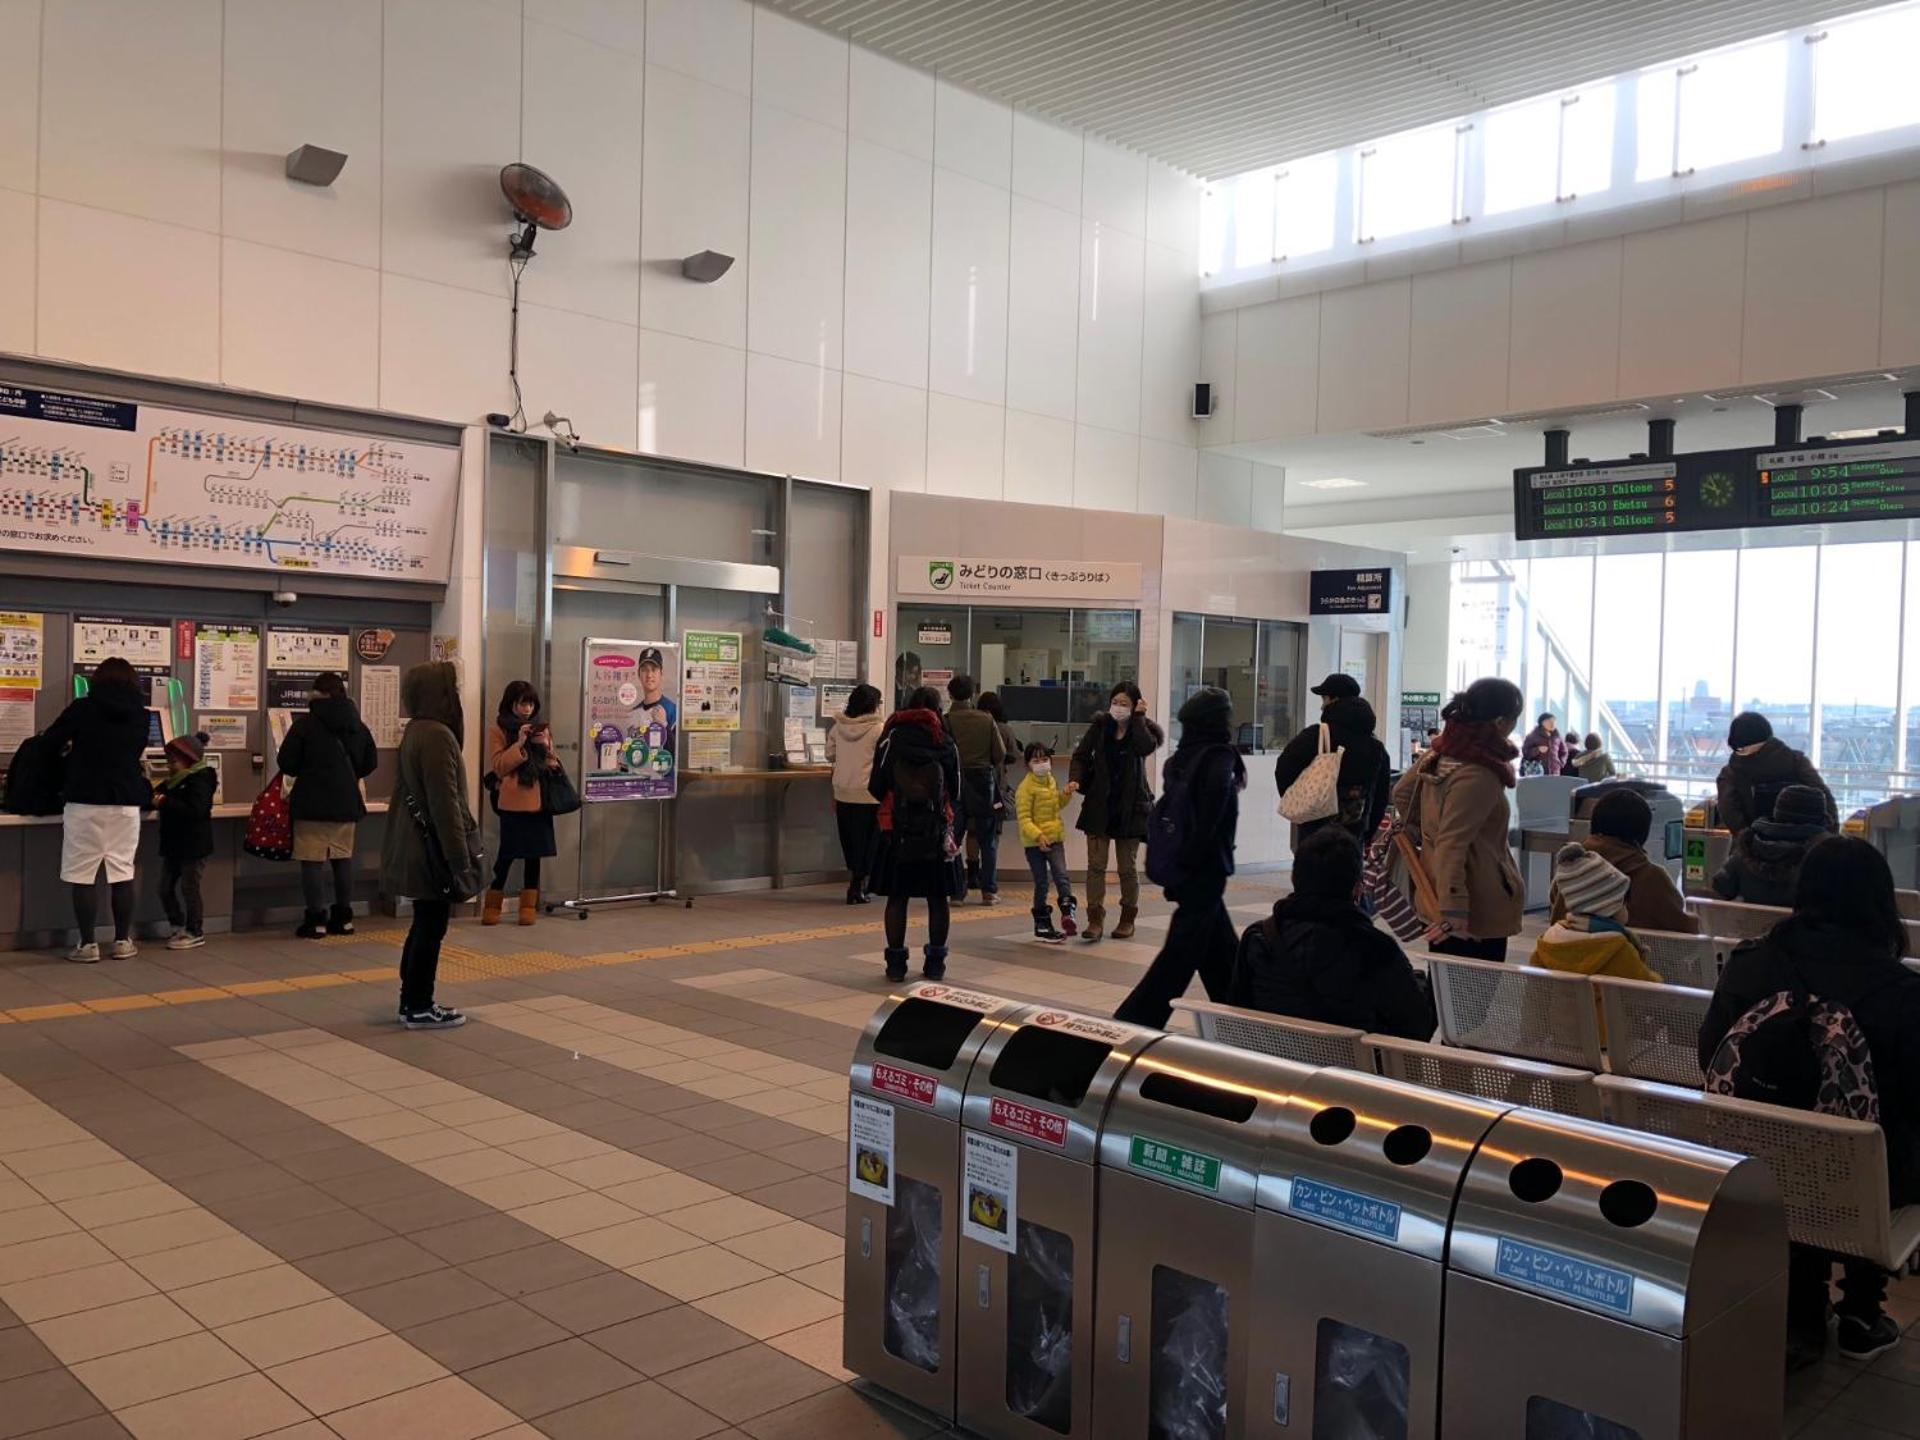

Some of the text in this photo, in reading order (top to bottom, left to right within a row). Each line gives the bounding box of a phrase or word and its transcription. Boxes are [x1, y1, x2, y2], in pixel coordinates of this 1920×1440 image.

[1771, 470, 1797, 482] Local
[1810, 465, 1848, 480] 9:54
[1543, 479, 1675, 500] Local 10:03 Chitose 5
[1771, 487, 1798, 500] Local
[1801, 483, 1849, 498] 10:03
[1543, 495, 1674, 515] Local 10:30 Ebetsu 6
[1771, 504, 1798, 516] Local
[1801, 500, 1848, 514] 10:24
[1544, 511, 1674, 530] Local 10:34 Chitose 5
[959, 564, 1042, 580] みどりの窓口
[959, 581, 1011, 591] Ticket Counter
[876, 1067, 933, 1095] もえるゴミ・その他
[994, 1102, 1063, 1135] もえるゴミ・その他
[1143, 1143, 1207, 1174] 新聞・雑誌
[1295, 1184, 1395, 1223] カン・ビン・ペットボトル
[1502, 1246, 1627, 1295] カン・ビン・ペットボトル
